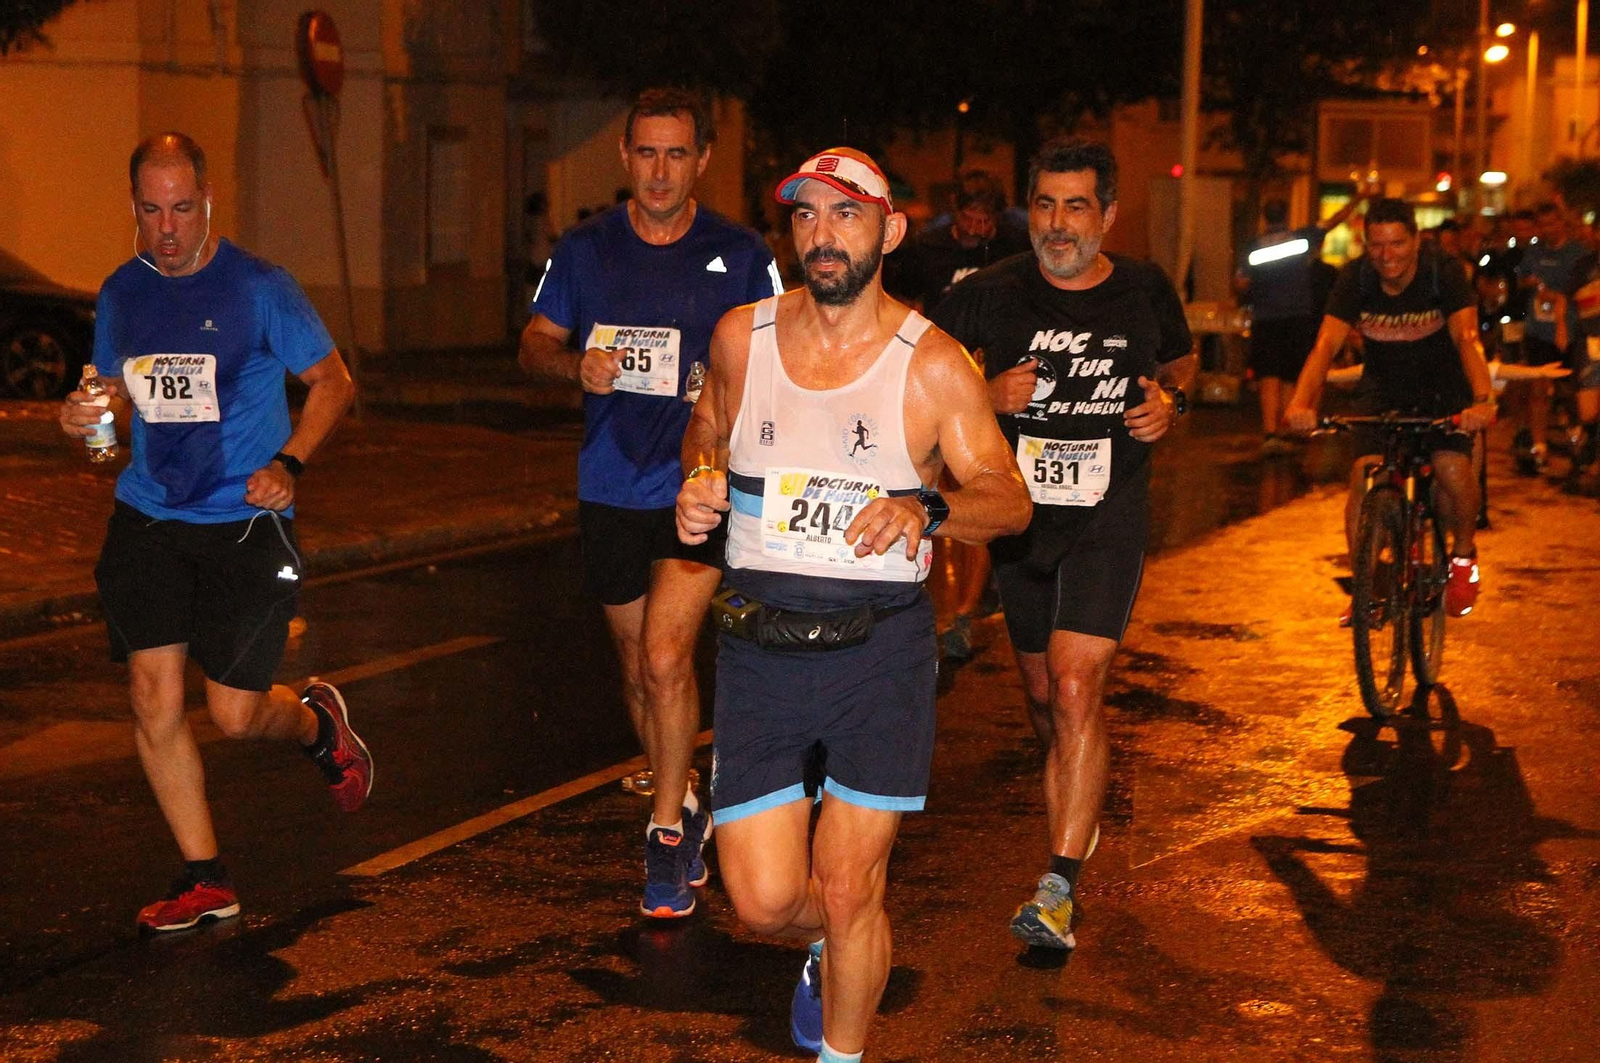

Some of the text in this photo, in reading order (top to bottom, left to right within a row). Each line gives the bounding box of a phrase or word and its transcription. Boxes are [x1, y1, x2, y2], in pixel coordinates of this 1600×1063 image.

[616, 328, 670, 339] NOCTURNA
[629, 338, 668, 348] HUELVA
[1028, 328, 1092, 354] NOC
[154, 356, 205, 366] NOCTURNA
[165, 366, 203, 376] HUELVA
[1067, 357, 1114, 377] TUR
[144, 375, 193, 400] 782
[1090, 376, 1130, 401] NA
[1047, 401, 1071, 414] DE
[1071, 401, 1125, 415] HUELVA
[1043, 441, 1099, 452] NOCTURNA
[1057, 451, 1097, 461] HUELVA
[1033, 458, 1079, 485] 531
[802, 487, 822, 499] DE
[805, 534, 832, 544] ALBERTO
